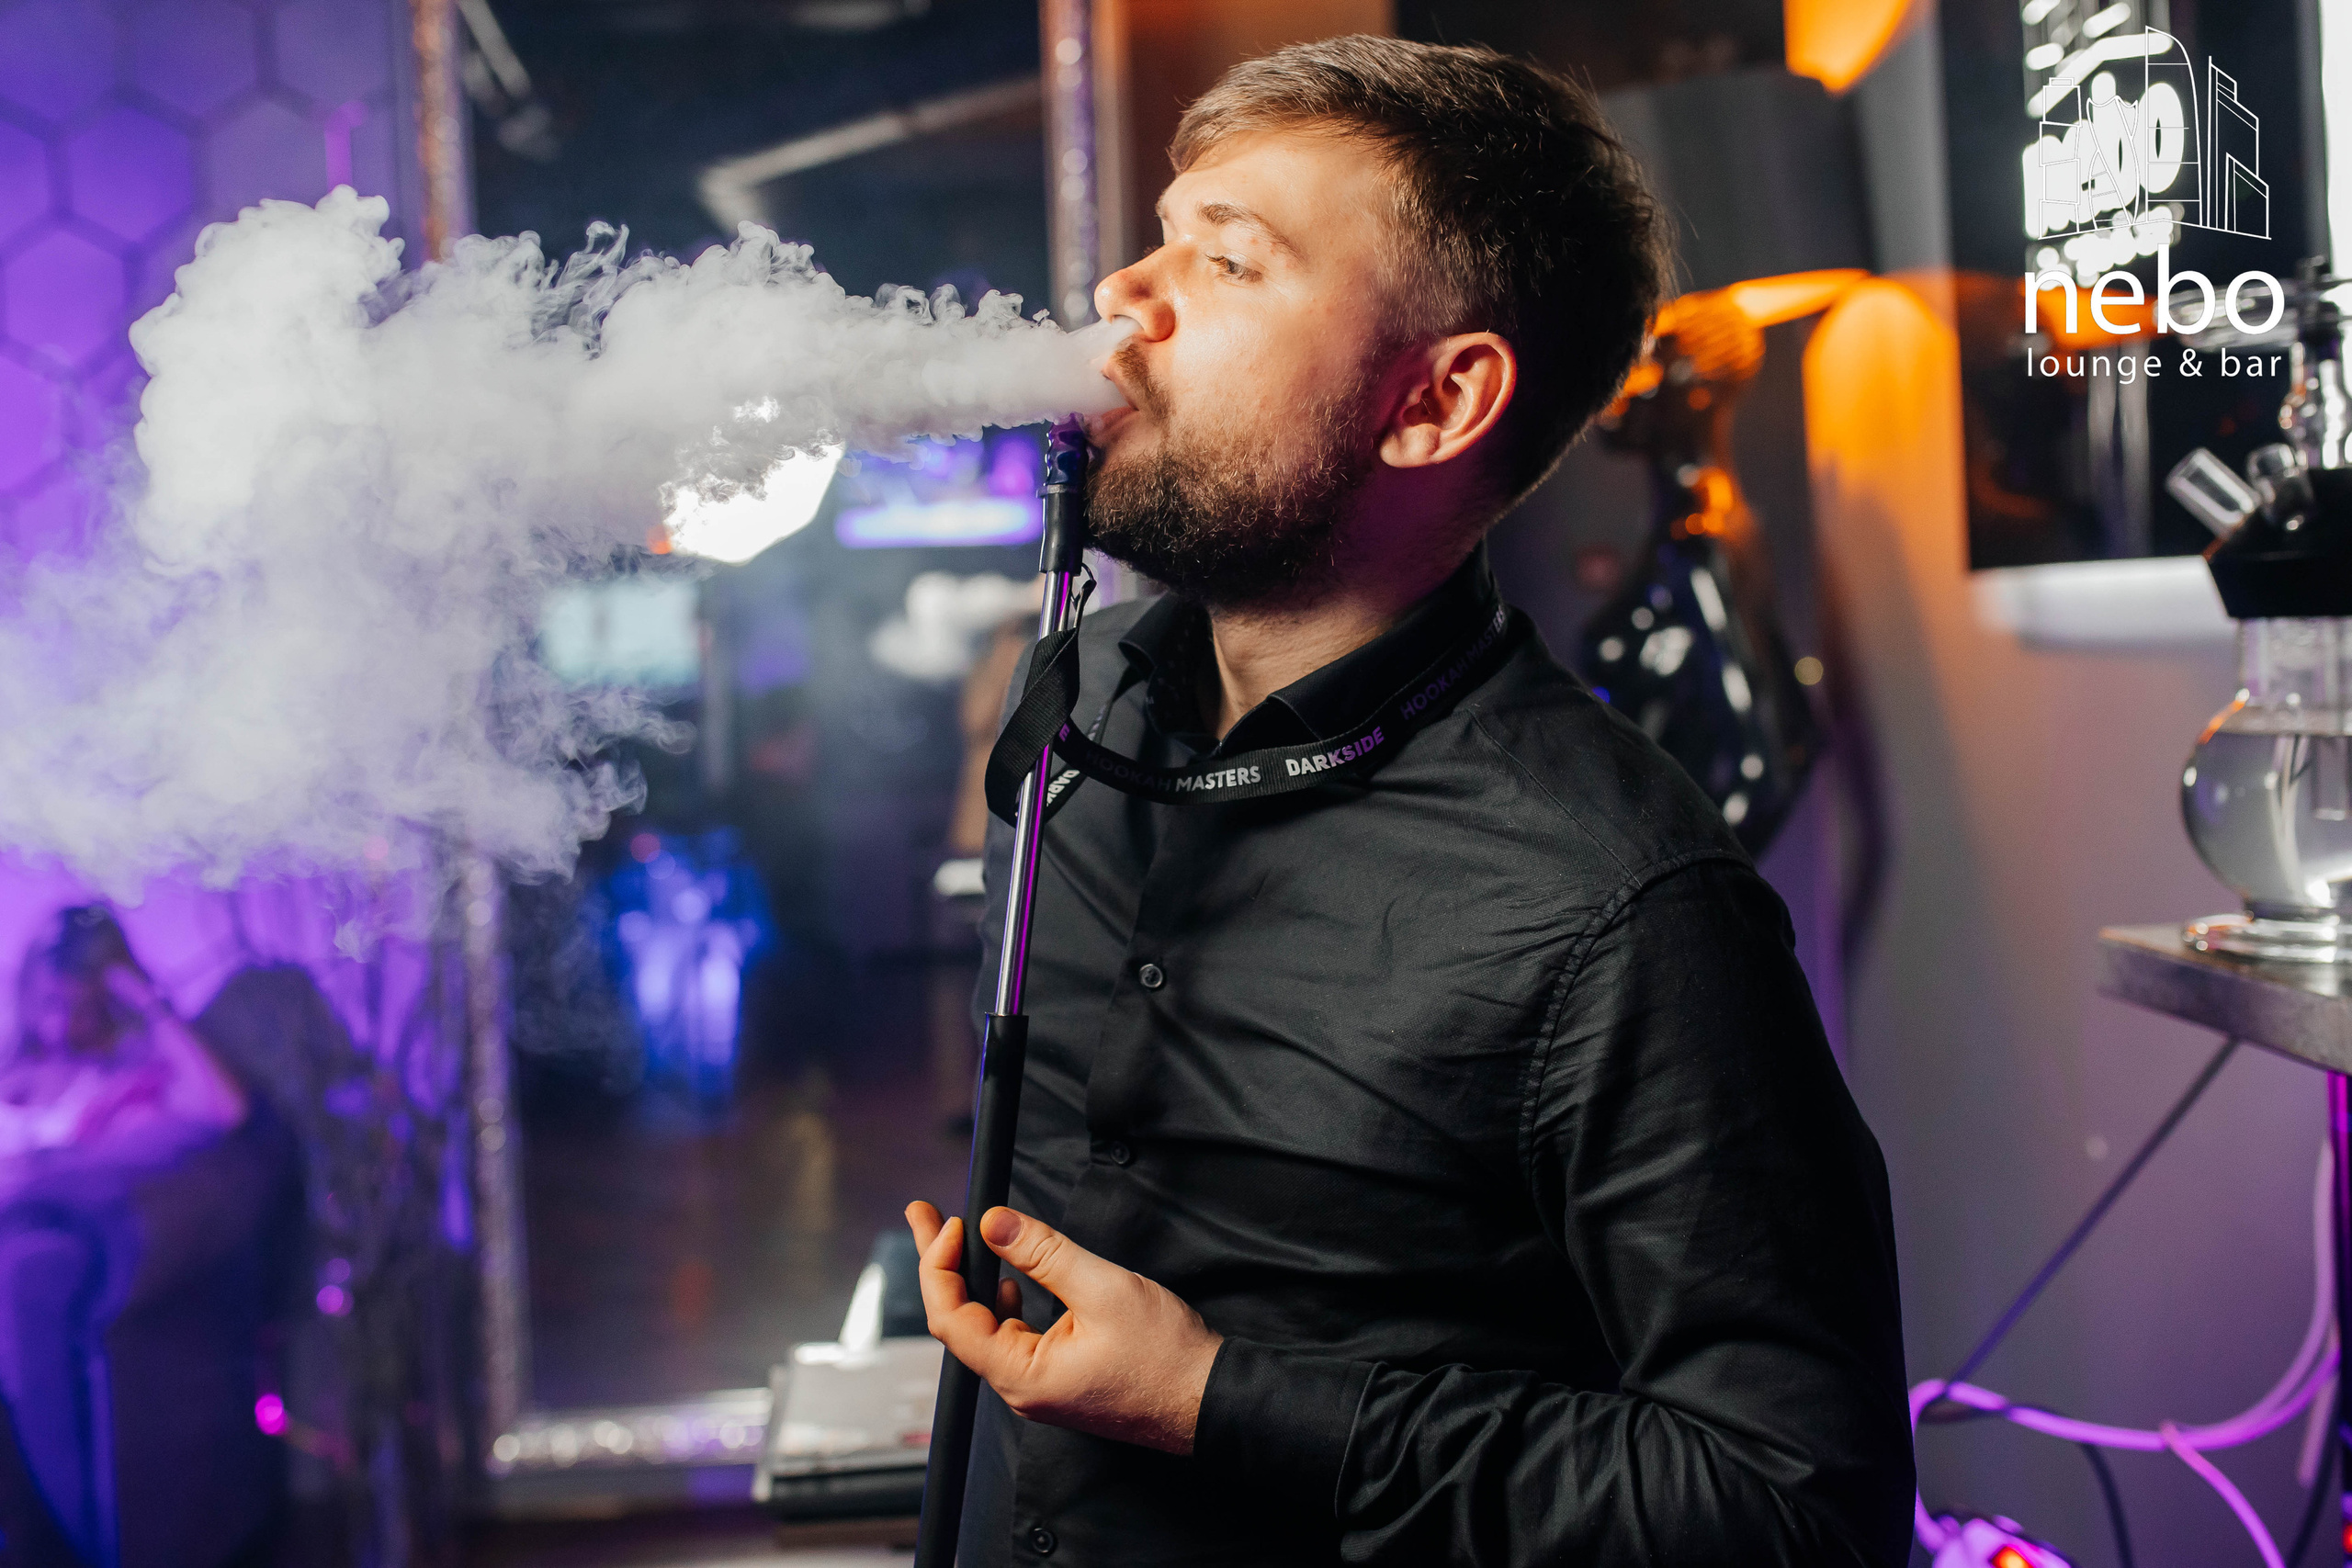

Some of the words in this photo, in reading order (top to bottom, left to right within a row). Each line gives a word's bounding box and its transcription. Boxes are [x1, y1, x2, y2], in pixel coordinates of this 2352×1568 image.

[1400, 659, 1468, 720] HOOKAH
[1175, 765, 1262, 793] MASTERS
[1284, 726, 1385, 777] DARKSIDE
